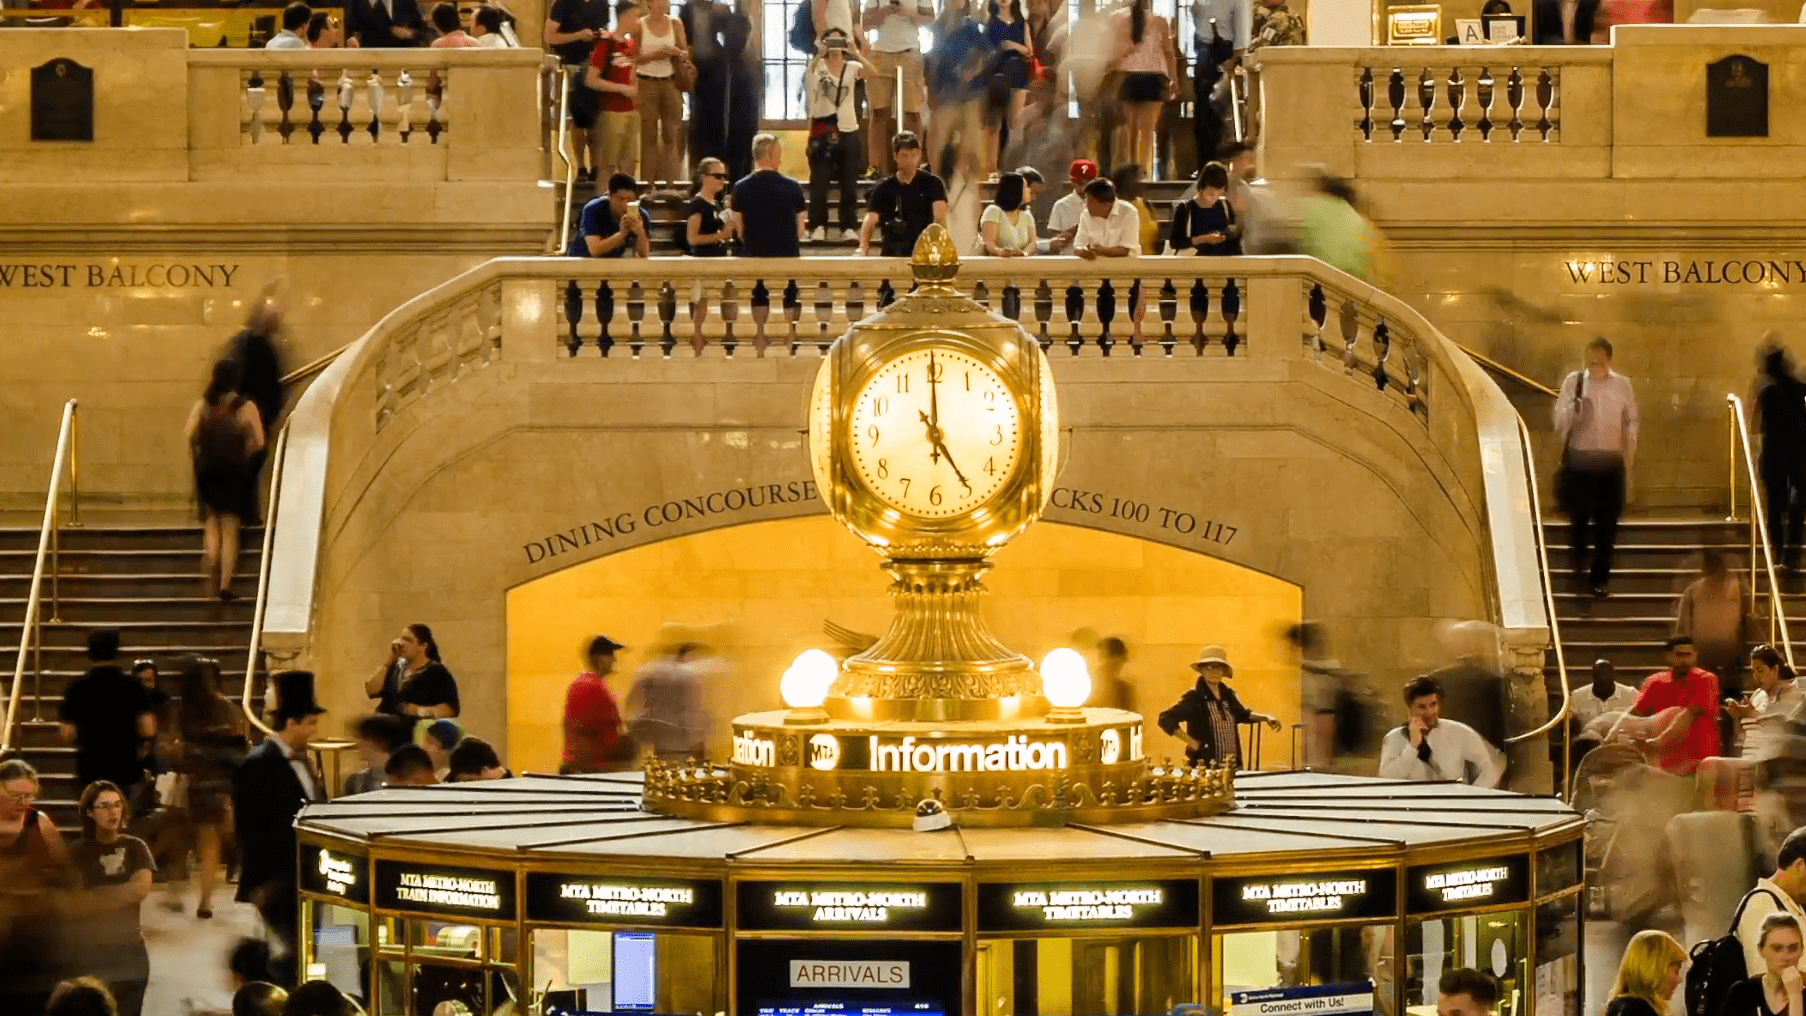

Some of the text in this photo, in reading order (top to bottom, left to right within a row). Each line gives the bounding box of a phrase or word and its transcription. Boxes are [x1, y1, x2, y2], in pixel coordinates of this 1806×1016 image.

[1465, 24, 1479, 42] A
[85, 264, 240, 288] BALCONY
[1564, 261, 1806, 284] WEST BALCONY
[896, 372, 909, 393] 11
[965, 371, 970, 391] 1
[873, 395, 889, 417] 10
[983, 390, 995, 411] 2
[867, 425, 880, 448] 9
[989, 424, 1003, 446] 3
[877, 458, 889, 480] 8
[982, 455, 997, 476] 4
[899, 477, 912, 498] 7
[929, 485, 942, 506] 6
[522, 480, 817, 565] DINING CONCOURSE
[1047, 487, 1239, 546] CKS 100 TO 117
[869, 735, 1067, 772] Information
[396, 887, 427, 901] TRAIN
[401, 873, 495, 894] MTA METRO-NORTH
[560, 883, 591, 899] MTA
[774, 891, 809, 906] MTA
[812, 906, 888, 921] ARRIVALS
[796, 964, 904, 983] ARRIVALS
[1260, 997, 1345, 1013] Connect with Us!
